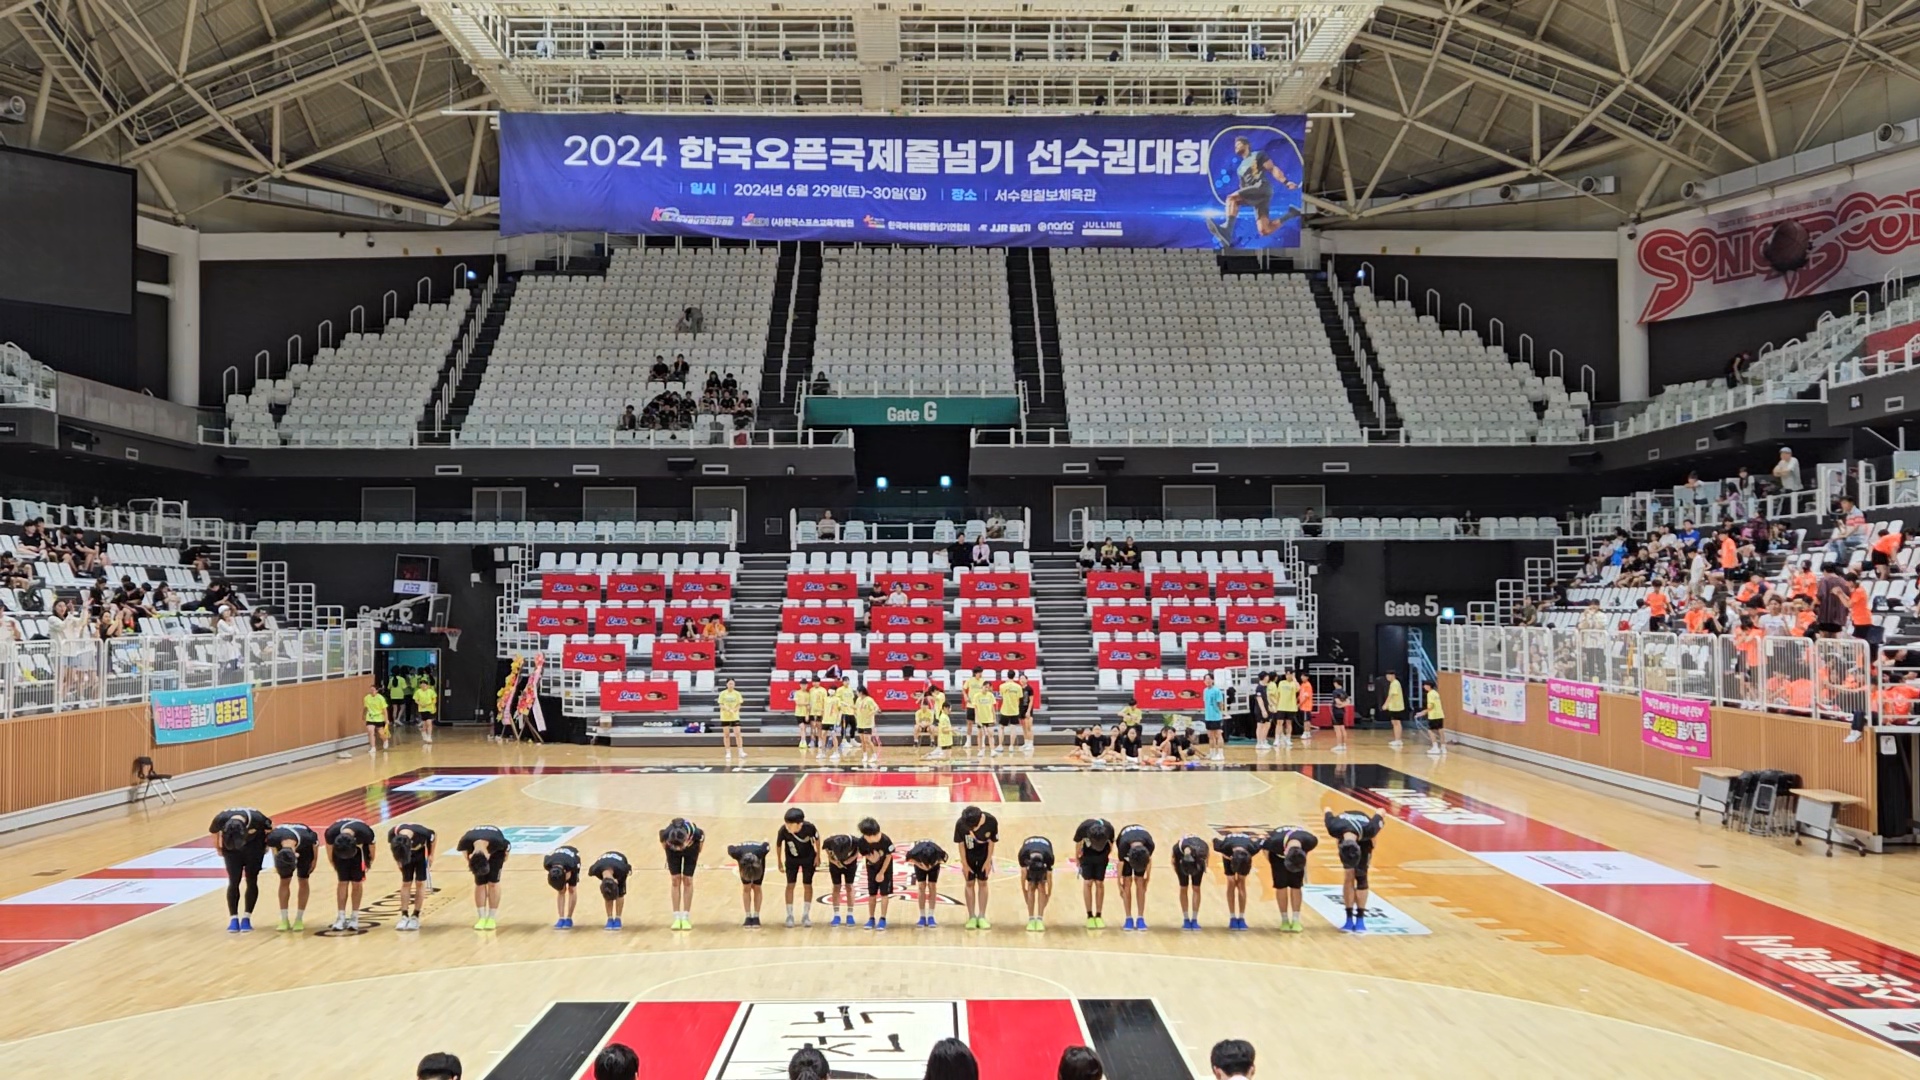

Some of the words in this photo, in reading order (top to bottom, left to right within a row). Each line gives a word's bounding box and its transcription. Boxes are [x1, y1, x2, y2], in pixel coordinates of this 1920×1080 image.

[563, 134, 667, 167] 2024
[678, 136, 1014, 174] 한국오픈국제줄넘기
[1027, 138, 1207, 175] 선수권대회
[690, 182, 716, 195] 일시
[734, 184, 783, 196] 2024년
[786, 184, 809, 197] 6월
[812, 185, 927, 200] 29일(토)~30일(일)
[951, 188, 977, 201] 장소
[995, 189, 1097, 202] 서수원칠보체육관
[1082, 221, 1123, 229] JULLINE
[887, 407, 920, 422] Gate
[924, 401, 938, 422] G
[1384, 600, 1421, 617] Gate
[1424, 594, 1439, 617] 5
